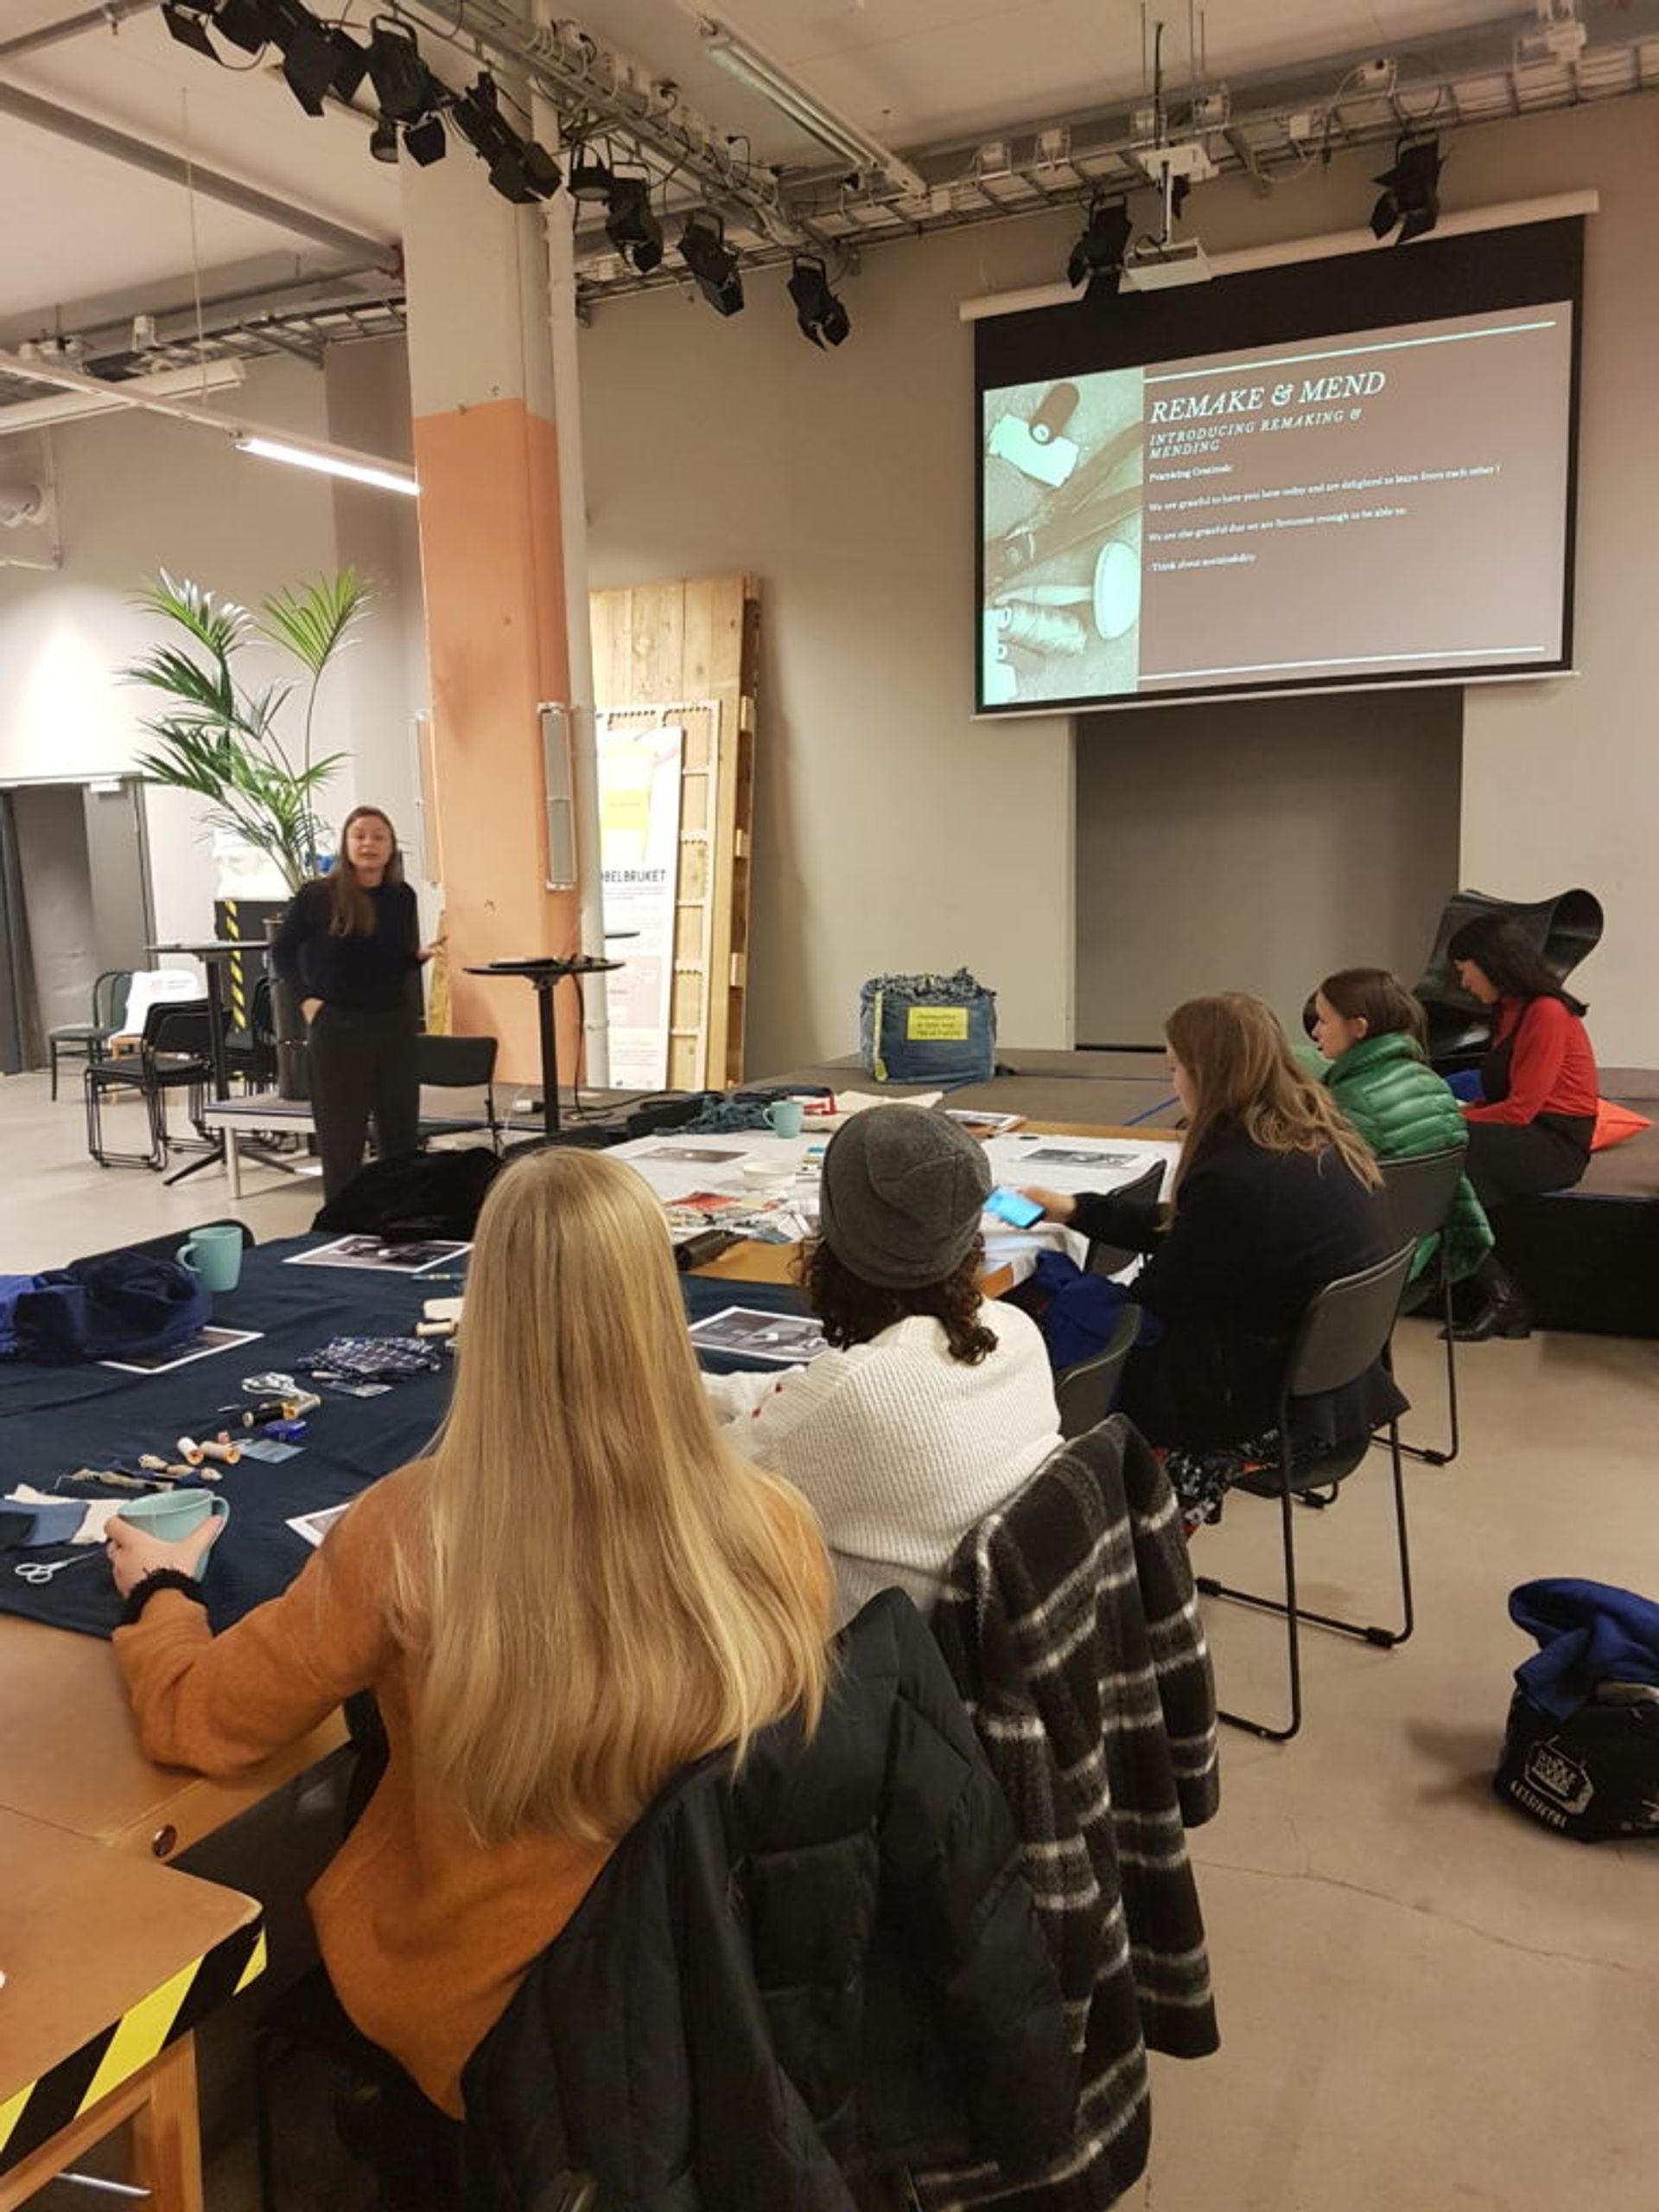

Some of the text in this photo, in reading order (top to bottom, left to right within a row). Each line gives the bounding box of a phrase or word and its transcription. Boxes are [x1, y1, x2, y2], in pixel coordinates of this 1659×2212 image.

[1150, 371, 1386, 424] REMAKE & MEND
[1149, 408, 1363, 446] INTRODUCING REMAKING &
[1148, 439, 1220, 460] MENDING
